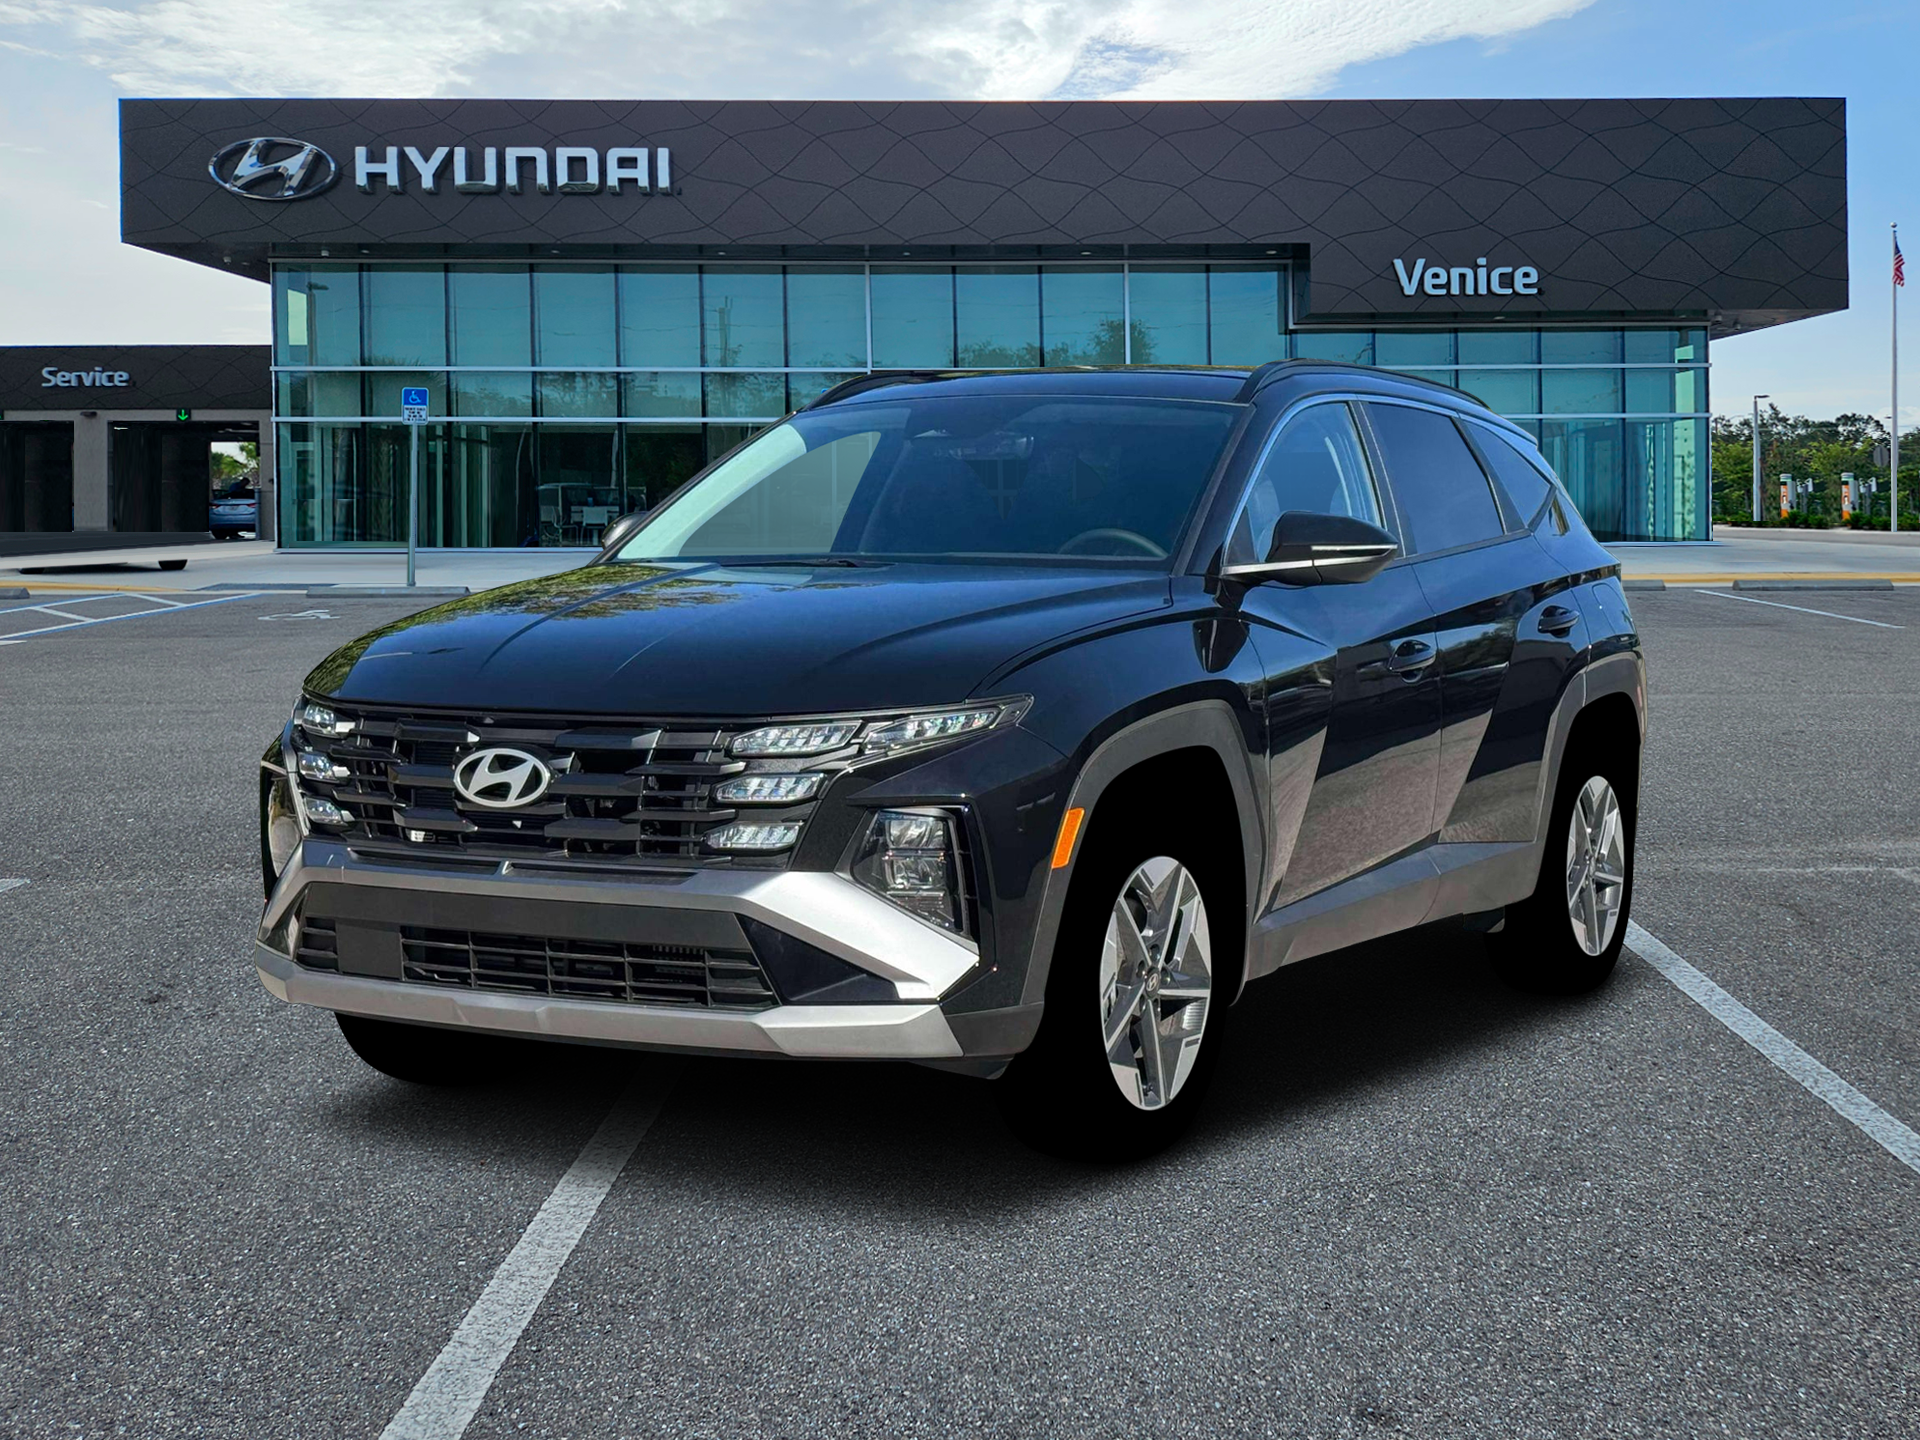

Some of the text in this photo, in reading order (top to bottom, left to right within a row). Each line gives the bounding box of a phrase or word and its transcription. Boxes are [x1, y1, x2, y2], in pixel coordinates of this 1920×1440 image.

[354, 146, 671, 195] HYUNDAI
[1392, 257, 1539, 296] Venice
[41, 366, 130, 387] Service
